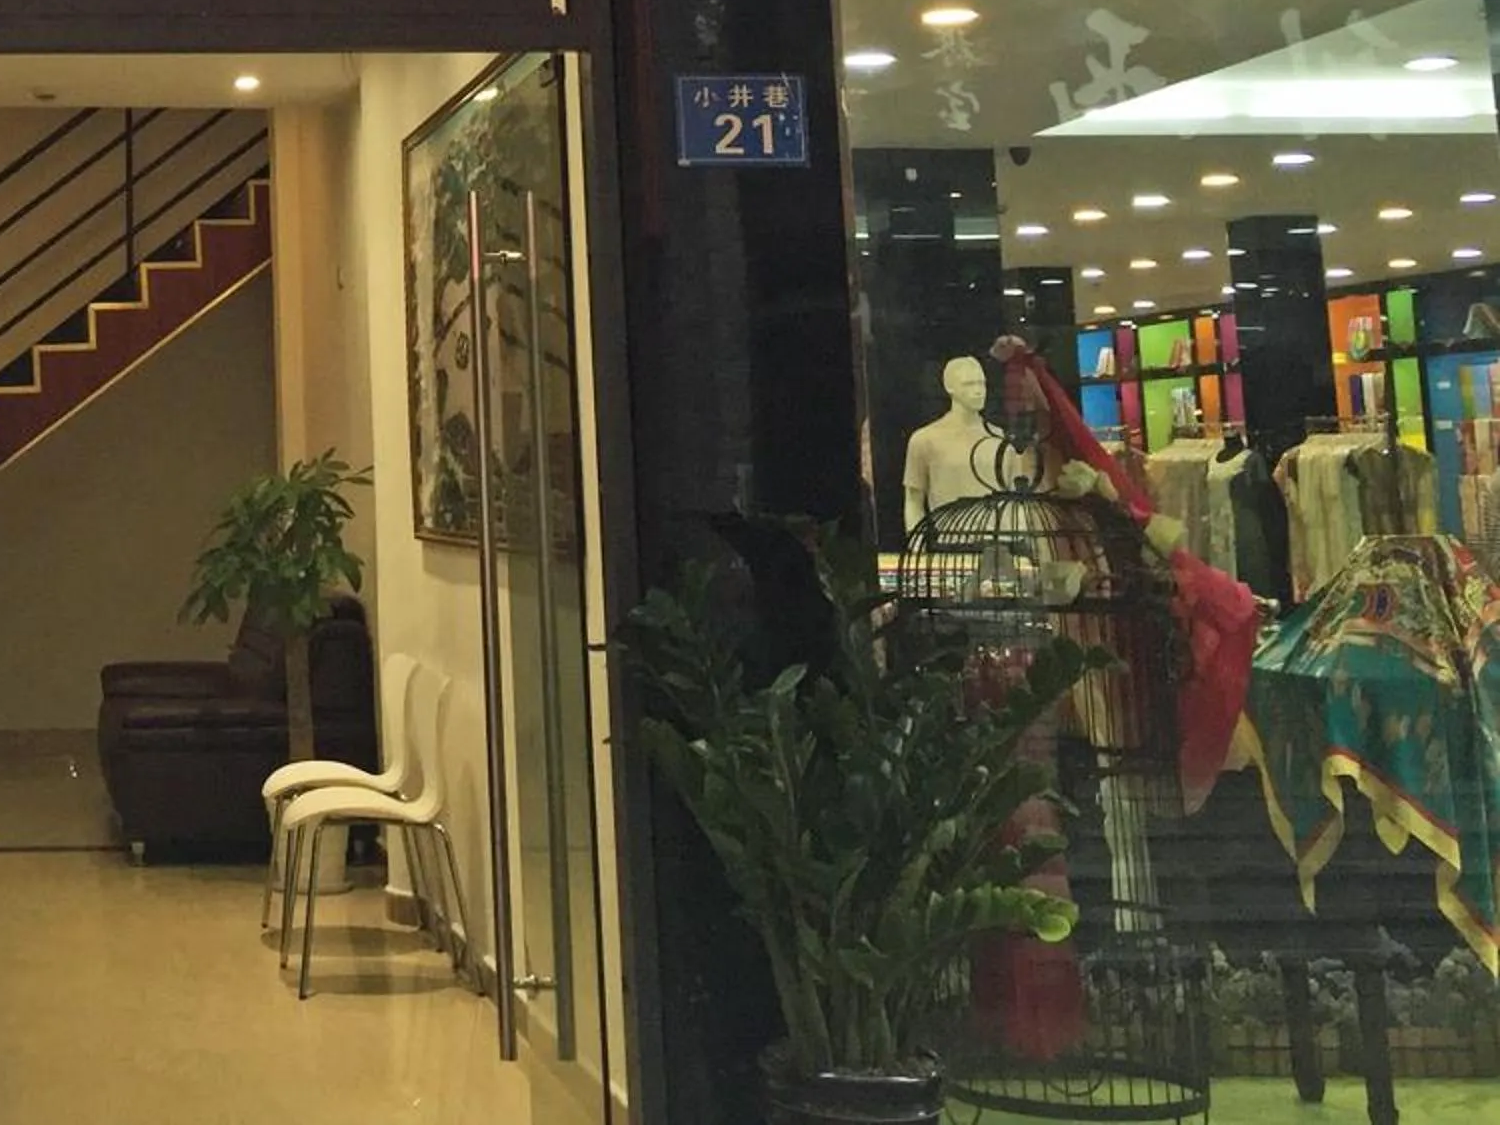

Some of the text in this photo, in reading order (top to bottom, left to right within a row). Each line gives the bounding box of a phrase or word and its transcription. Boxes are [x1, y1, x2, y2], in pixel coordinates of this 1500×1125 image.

[694, 84, 790, 108] 小井巷
[713, 113, 775, 155] 21
